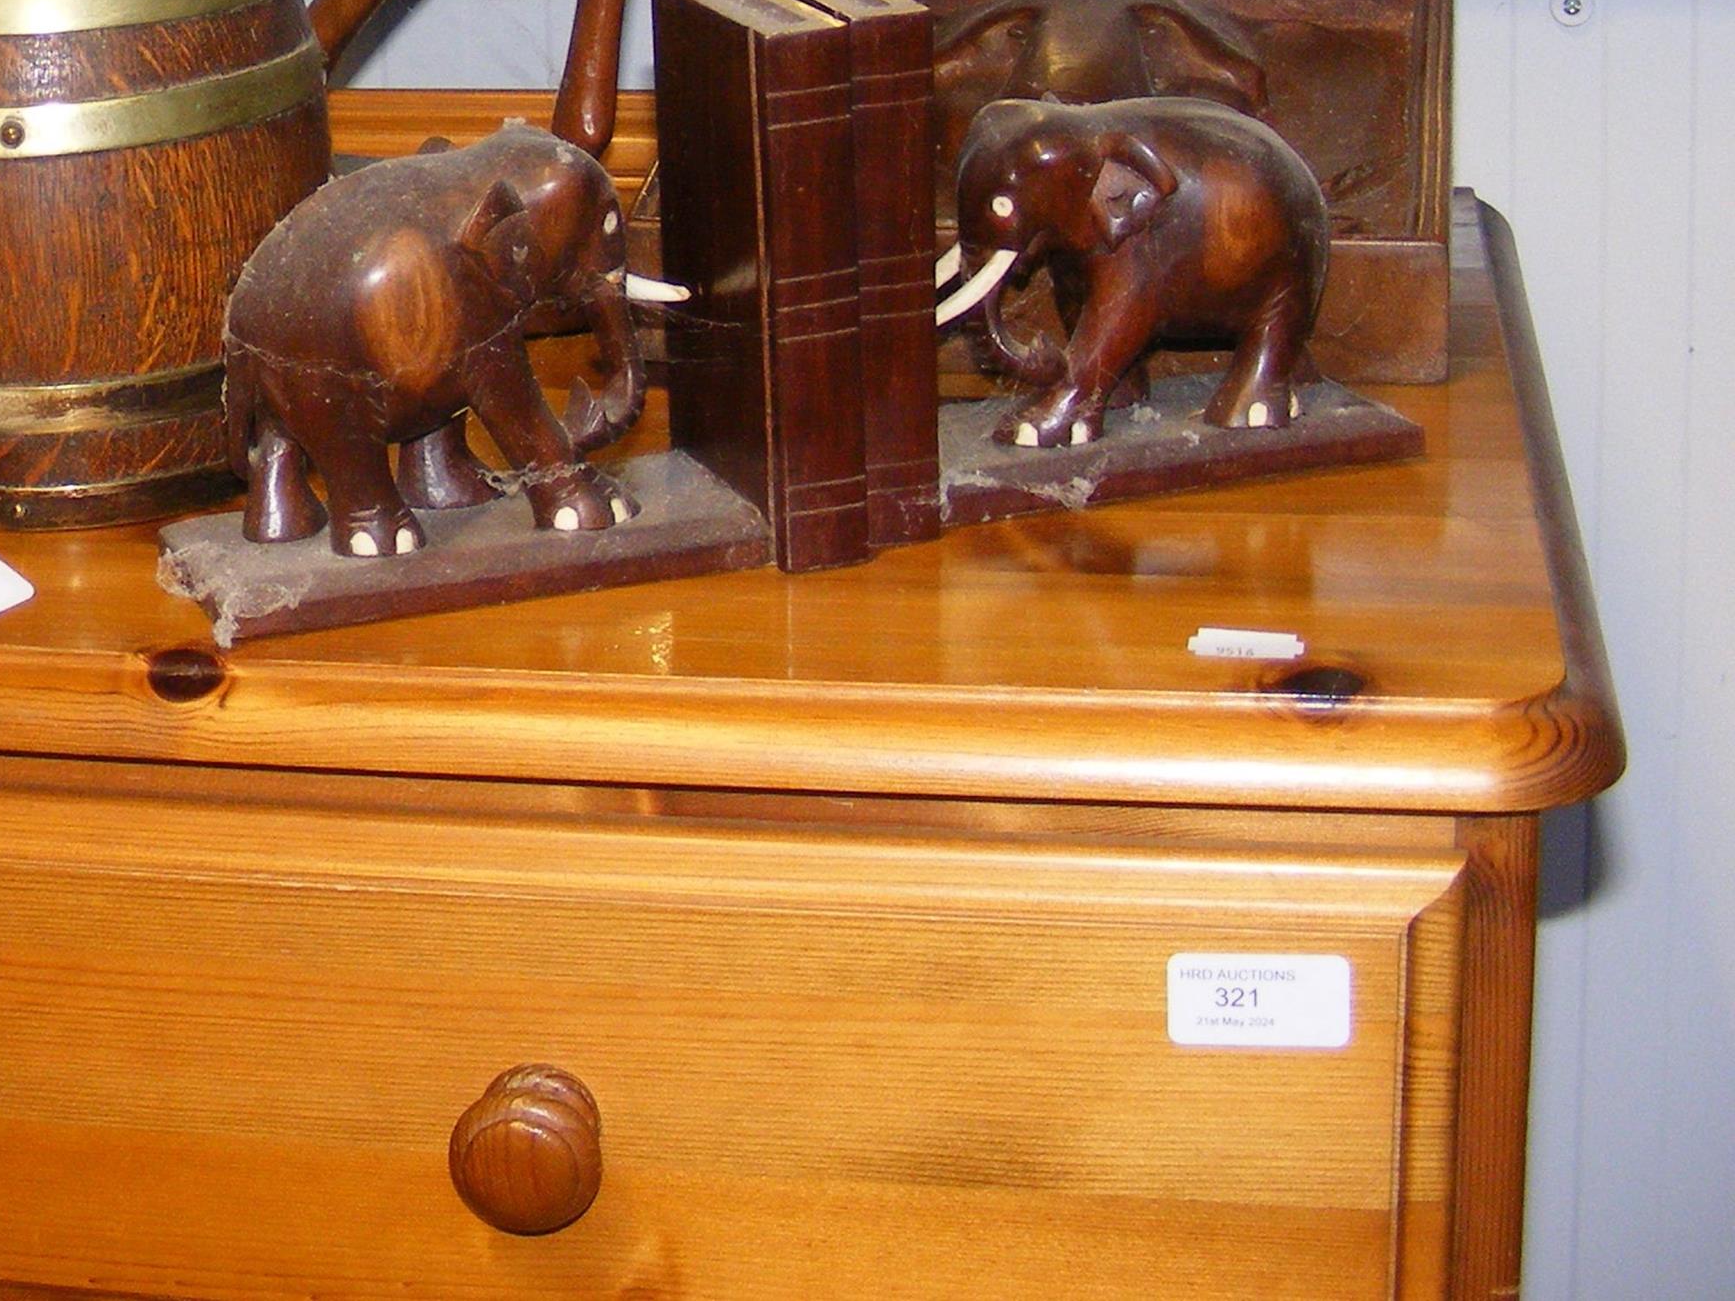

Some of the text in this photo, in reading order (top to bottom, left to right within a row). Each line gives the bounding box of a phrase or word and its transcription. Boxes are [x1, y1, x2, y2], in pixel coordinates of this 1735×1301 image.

[1179, 968, 1297, 982] HRD AUCTIONS
[1214, 986, 1259, 1008] 321
[1221, 1016, 1245, 1029] May
